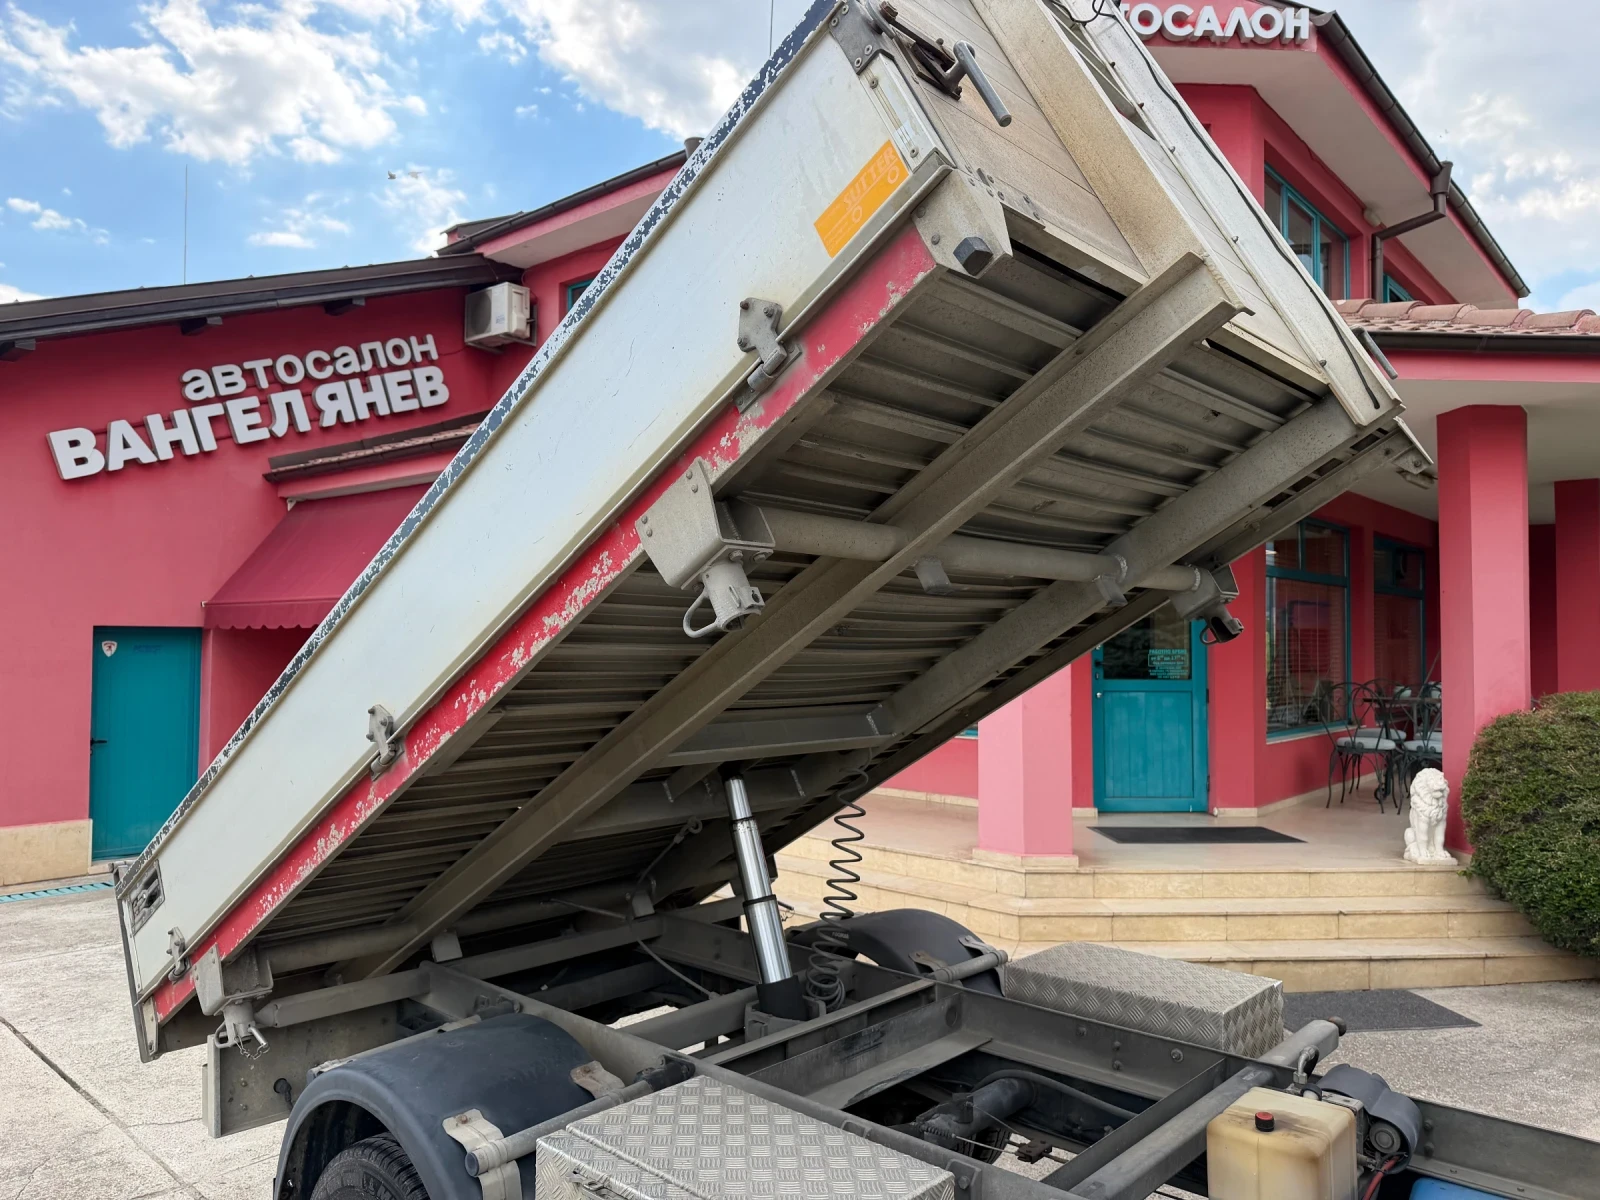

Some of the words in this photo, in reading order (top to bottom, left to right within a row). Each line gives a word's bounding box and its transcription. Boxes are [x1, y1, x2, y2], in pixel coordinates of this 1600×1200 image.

[842, 147, 898, 210] SUTTER
[182, 334, 438, 401] автосалон
[48, 390, 312, 480] ВАНГЕЛ
[314, 366, 450, 428] ЯНЕВ
